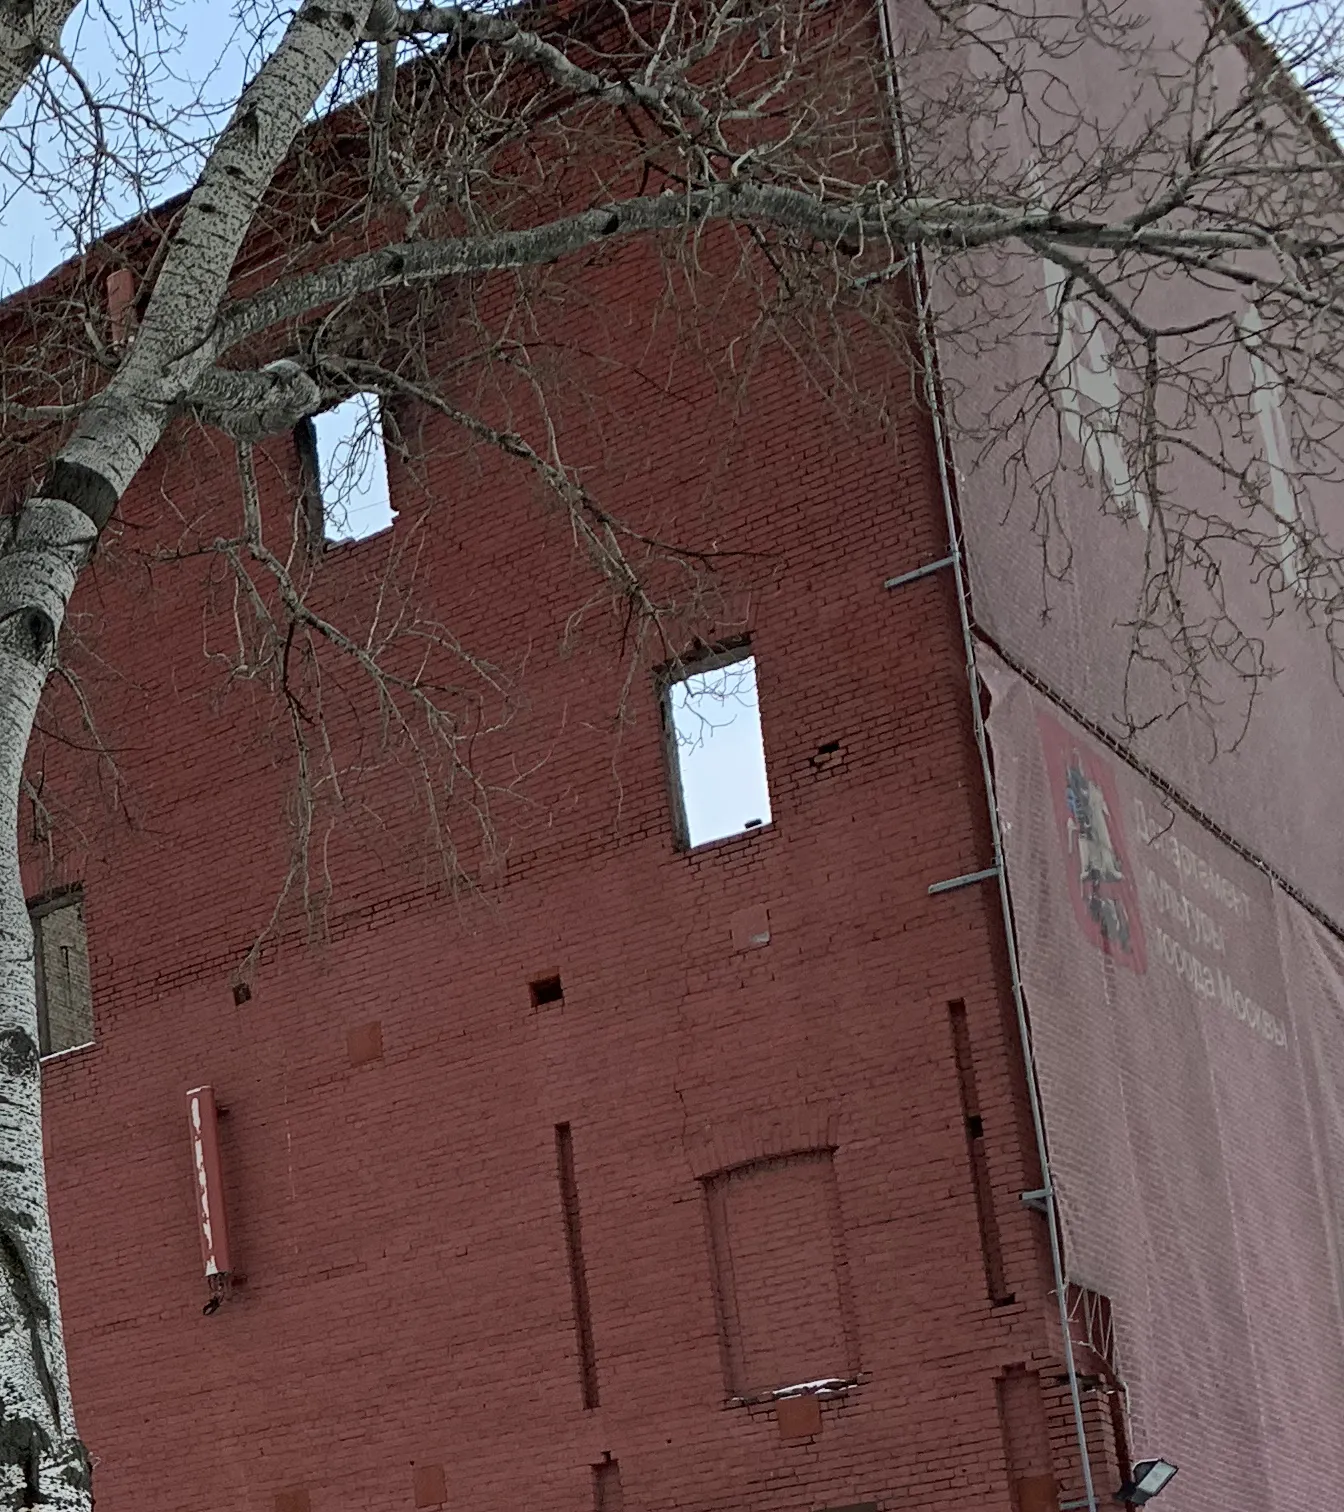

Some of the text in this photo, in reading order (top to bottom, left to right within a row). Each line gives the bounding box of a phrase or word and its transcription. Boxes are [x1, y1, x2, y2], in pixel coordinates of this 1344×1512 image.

[1133, 797, 1251, 920] Департамент
[1145, 866, 1226, 957] культуры
[1155, 927, 1288, 1051] города Москвы
